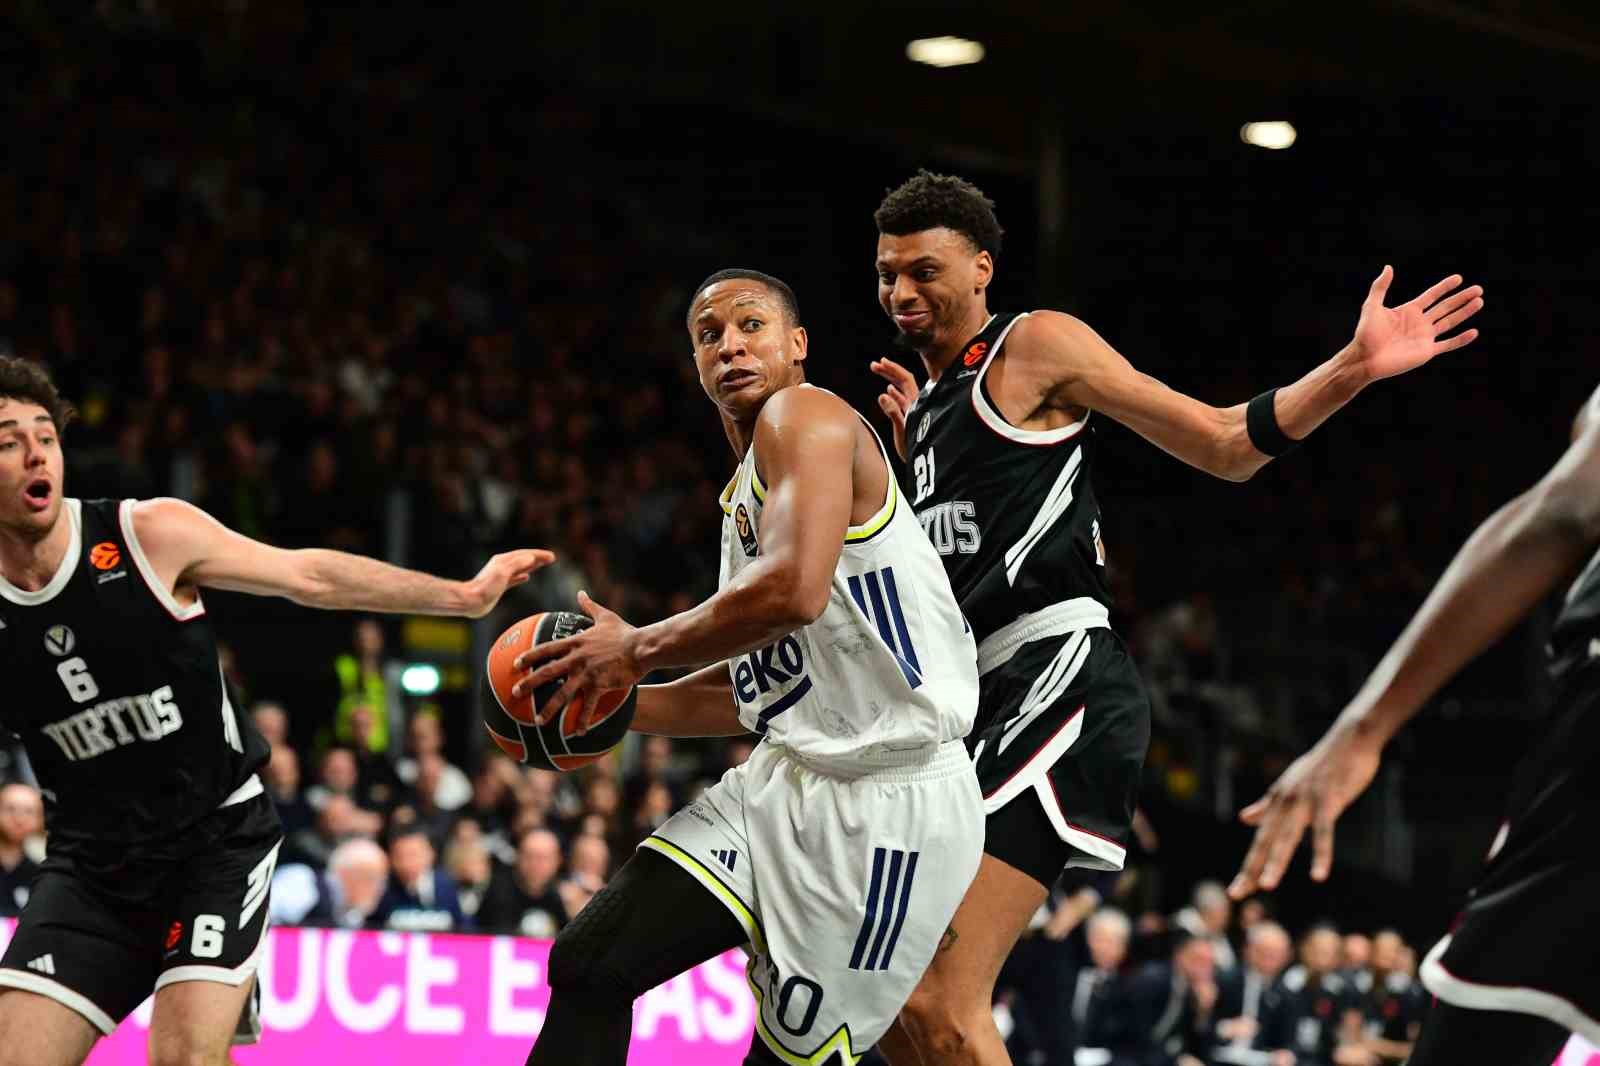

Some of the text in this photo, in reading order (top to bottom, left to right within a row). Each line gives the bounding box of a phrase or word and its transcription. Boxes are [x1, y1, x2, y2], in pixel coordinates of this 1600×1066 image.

[913, 446, 935, 507] 21
[916, 500, 981, 555] TUS
[57, 656, 99, 703] 6
[736, 635, 803, 703] eko
[190, 914, 226, 959] 6
[261, 928, 757, 1043] UCE E AS
[768, 966, 823, 1037] 0
